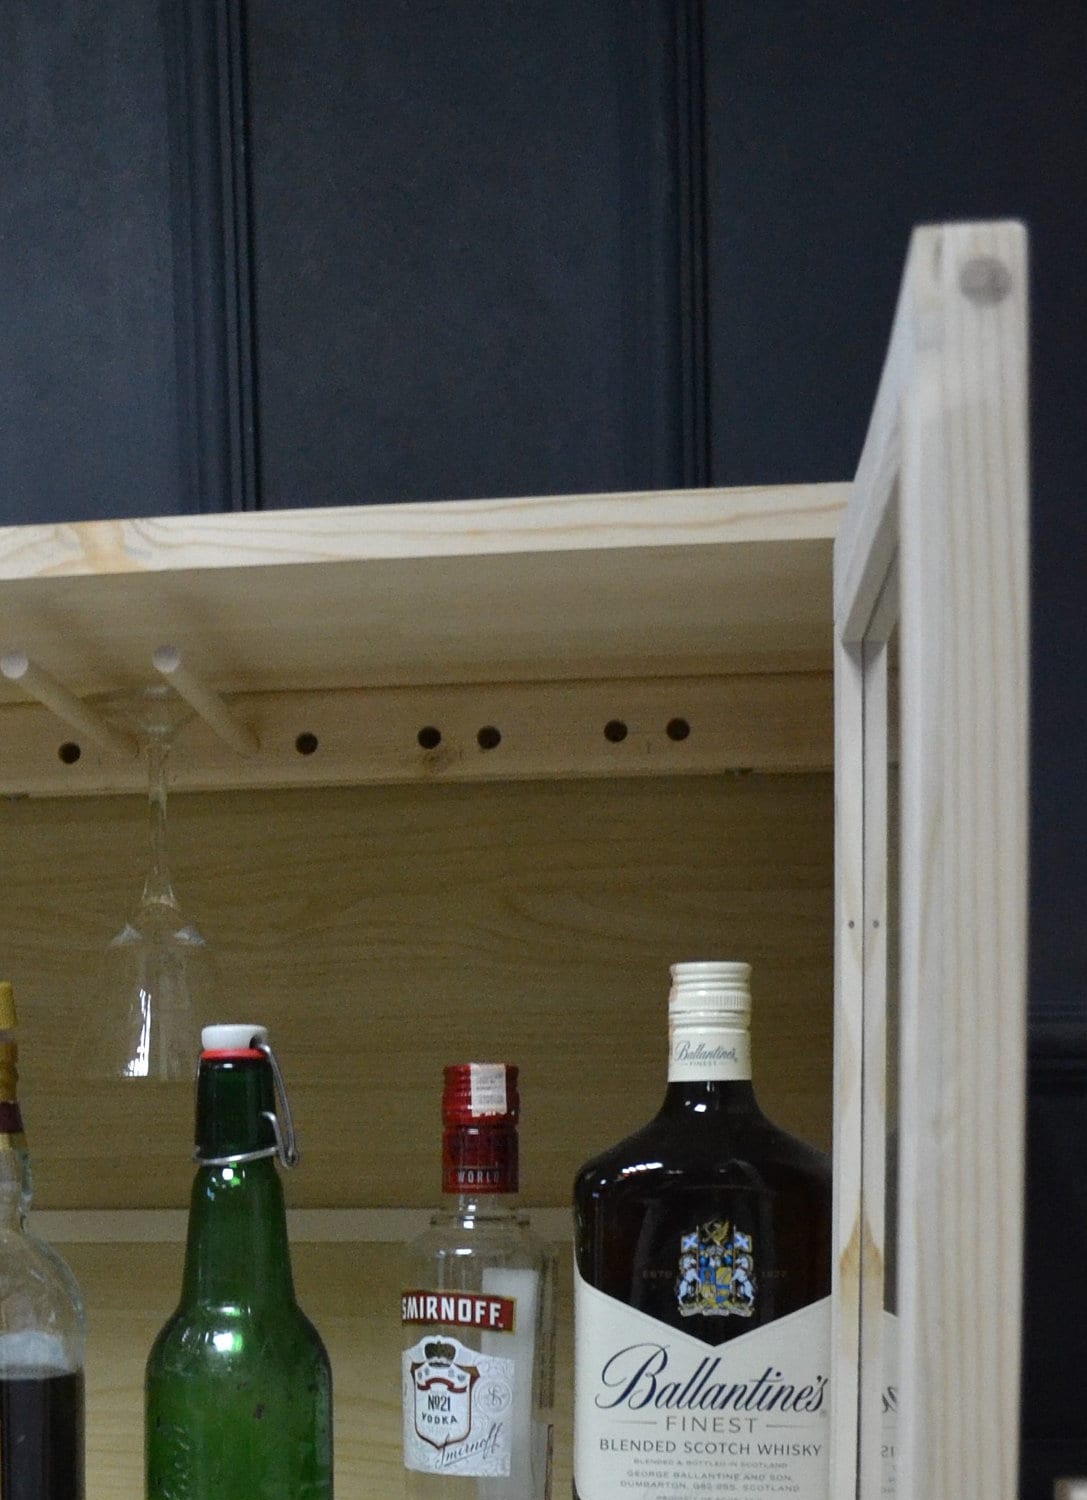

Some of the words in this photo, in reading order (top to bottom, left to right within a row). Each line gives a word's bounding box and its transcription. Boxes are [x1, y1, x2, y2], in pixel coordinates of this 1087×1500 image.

[457, 1169, 500, 1183] WORLD
[402, 1295, 502, 1327] SMIRNOFF
[595, 1342, 829, 1413] Ballantine's
[421, 1412, 458, 1425] VODKA
[665, 1415, 759, 1434] FINEST
[599, 1438, 677, 1452] BLENDED
[683, 1440, 751, 1455] SCOTCH
[757, 1443, 823, 1457] WHISKY
[627, 1470, 669, 1478] GEORGE
[673, 1471, 740, 1480] BALLANTINE
[744, 1473, 766, 1481] AND
[743, 1484, 800, 1493] SCOTLAND
